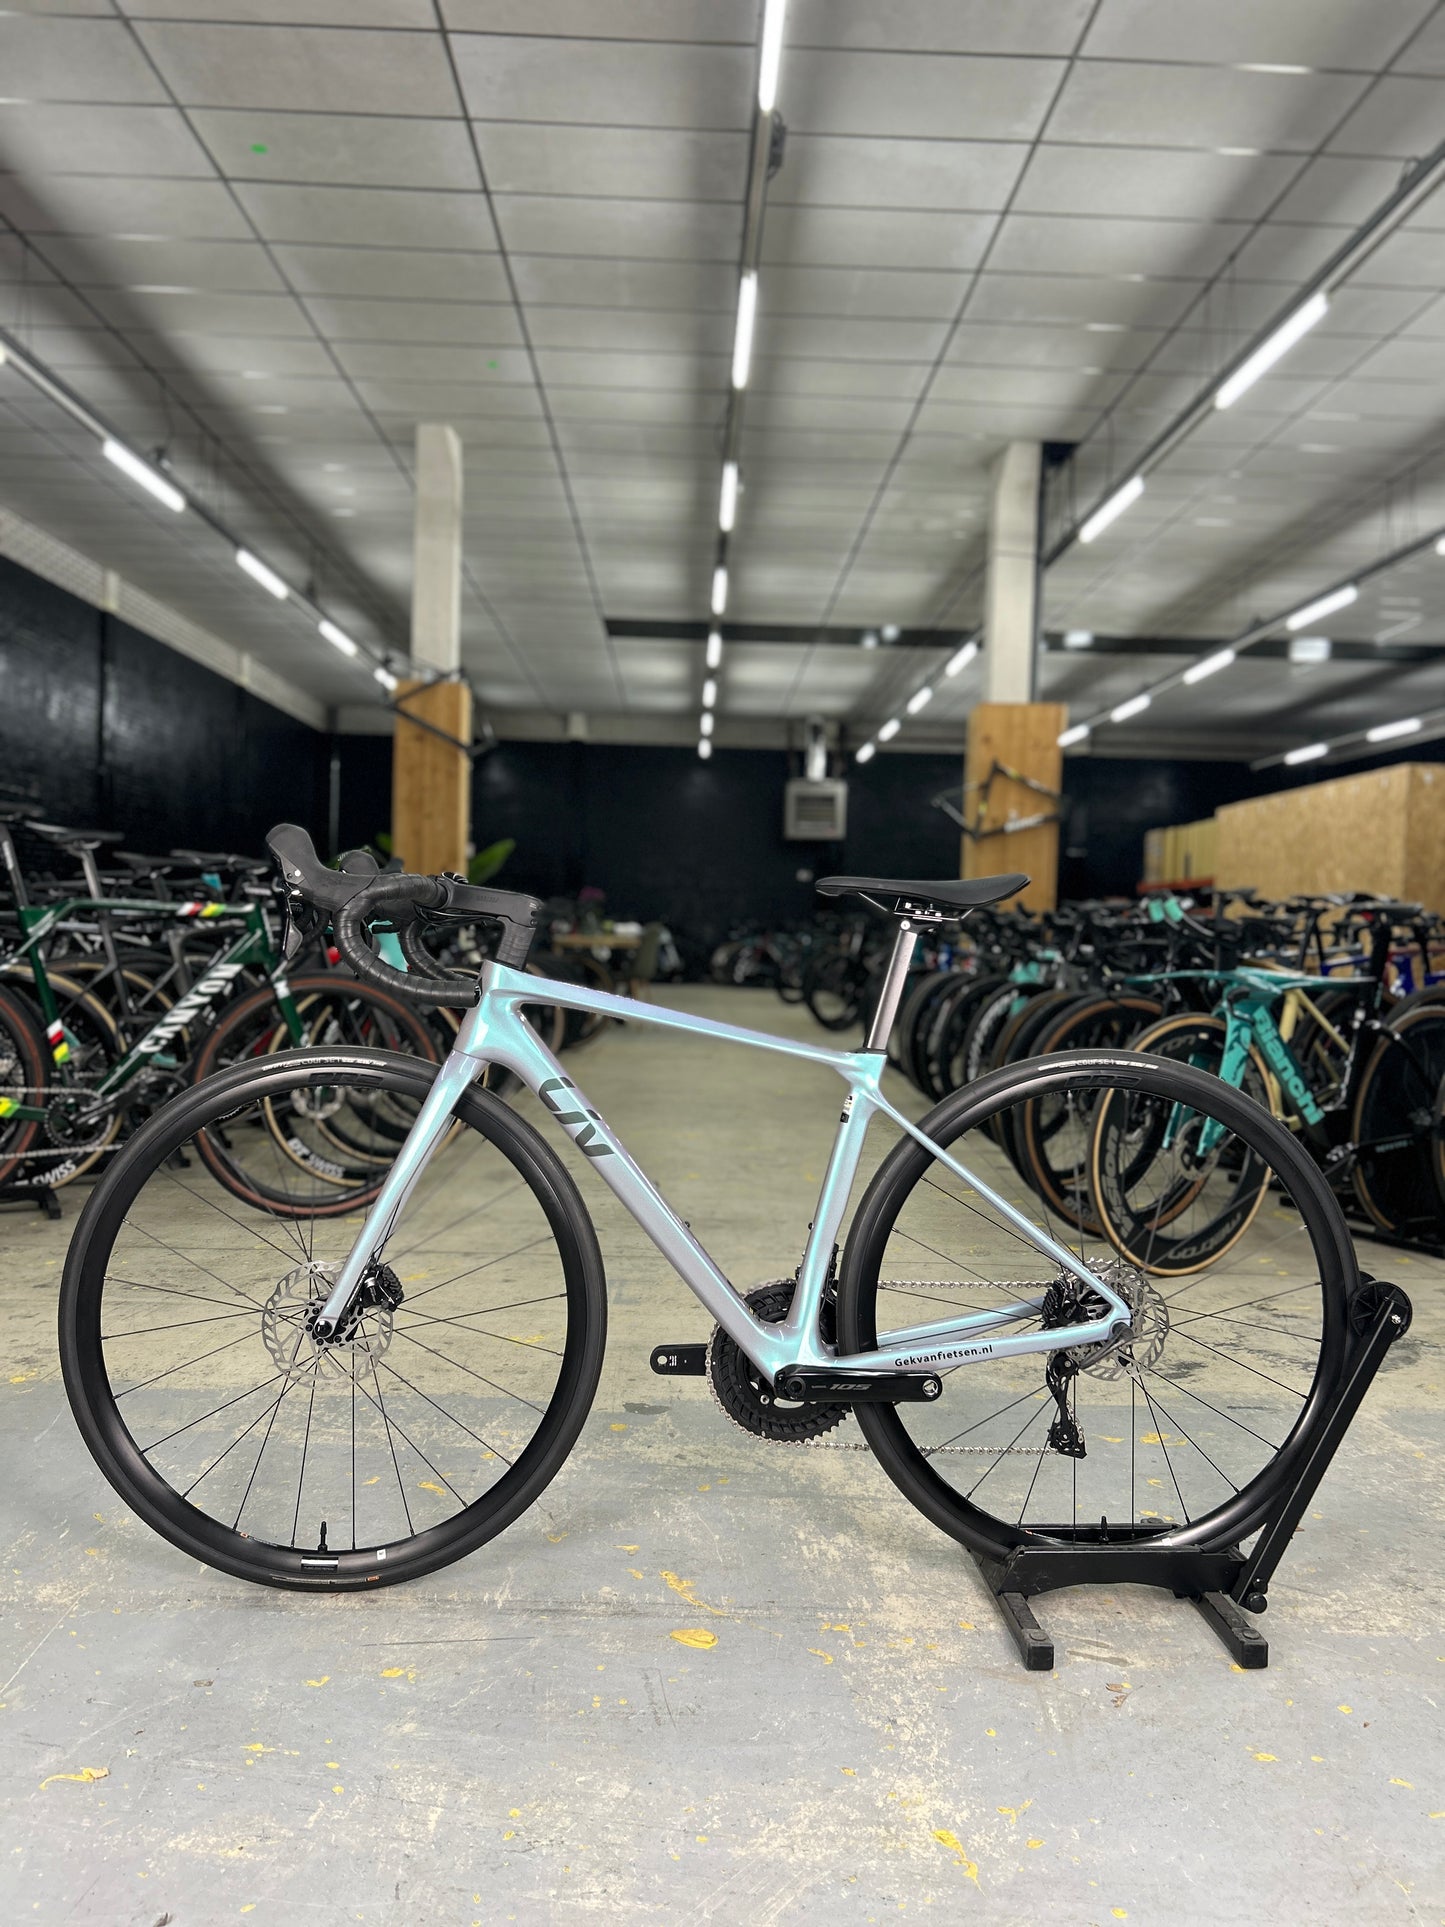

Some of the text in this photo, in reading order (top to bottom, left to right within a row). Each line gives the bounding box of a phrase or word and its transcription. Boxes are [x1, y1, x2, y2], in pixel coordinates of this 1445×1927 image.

[138, 963, 244, 1053] CANYON
[1252, 1006, 1325, 1125] Bianchi
[894, 1345, 993, 1367] Gekvanfietsen.nl
[829, 1383, 873, 1391] 105
